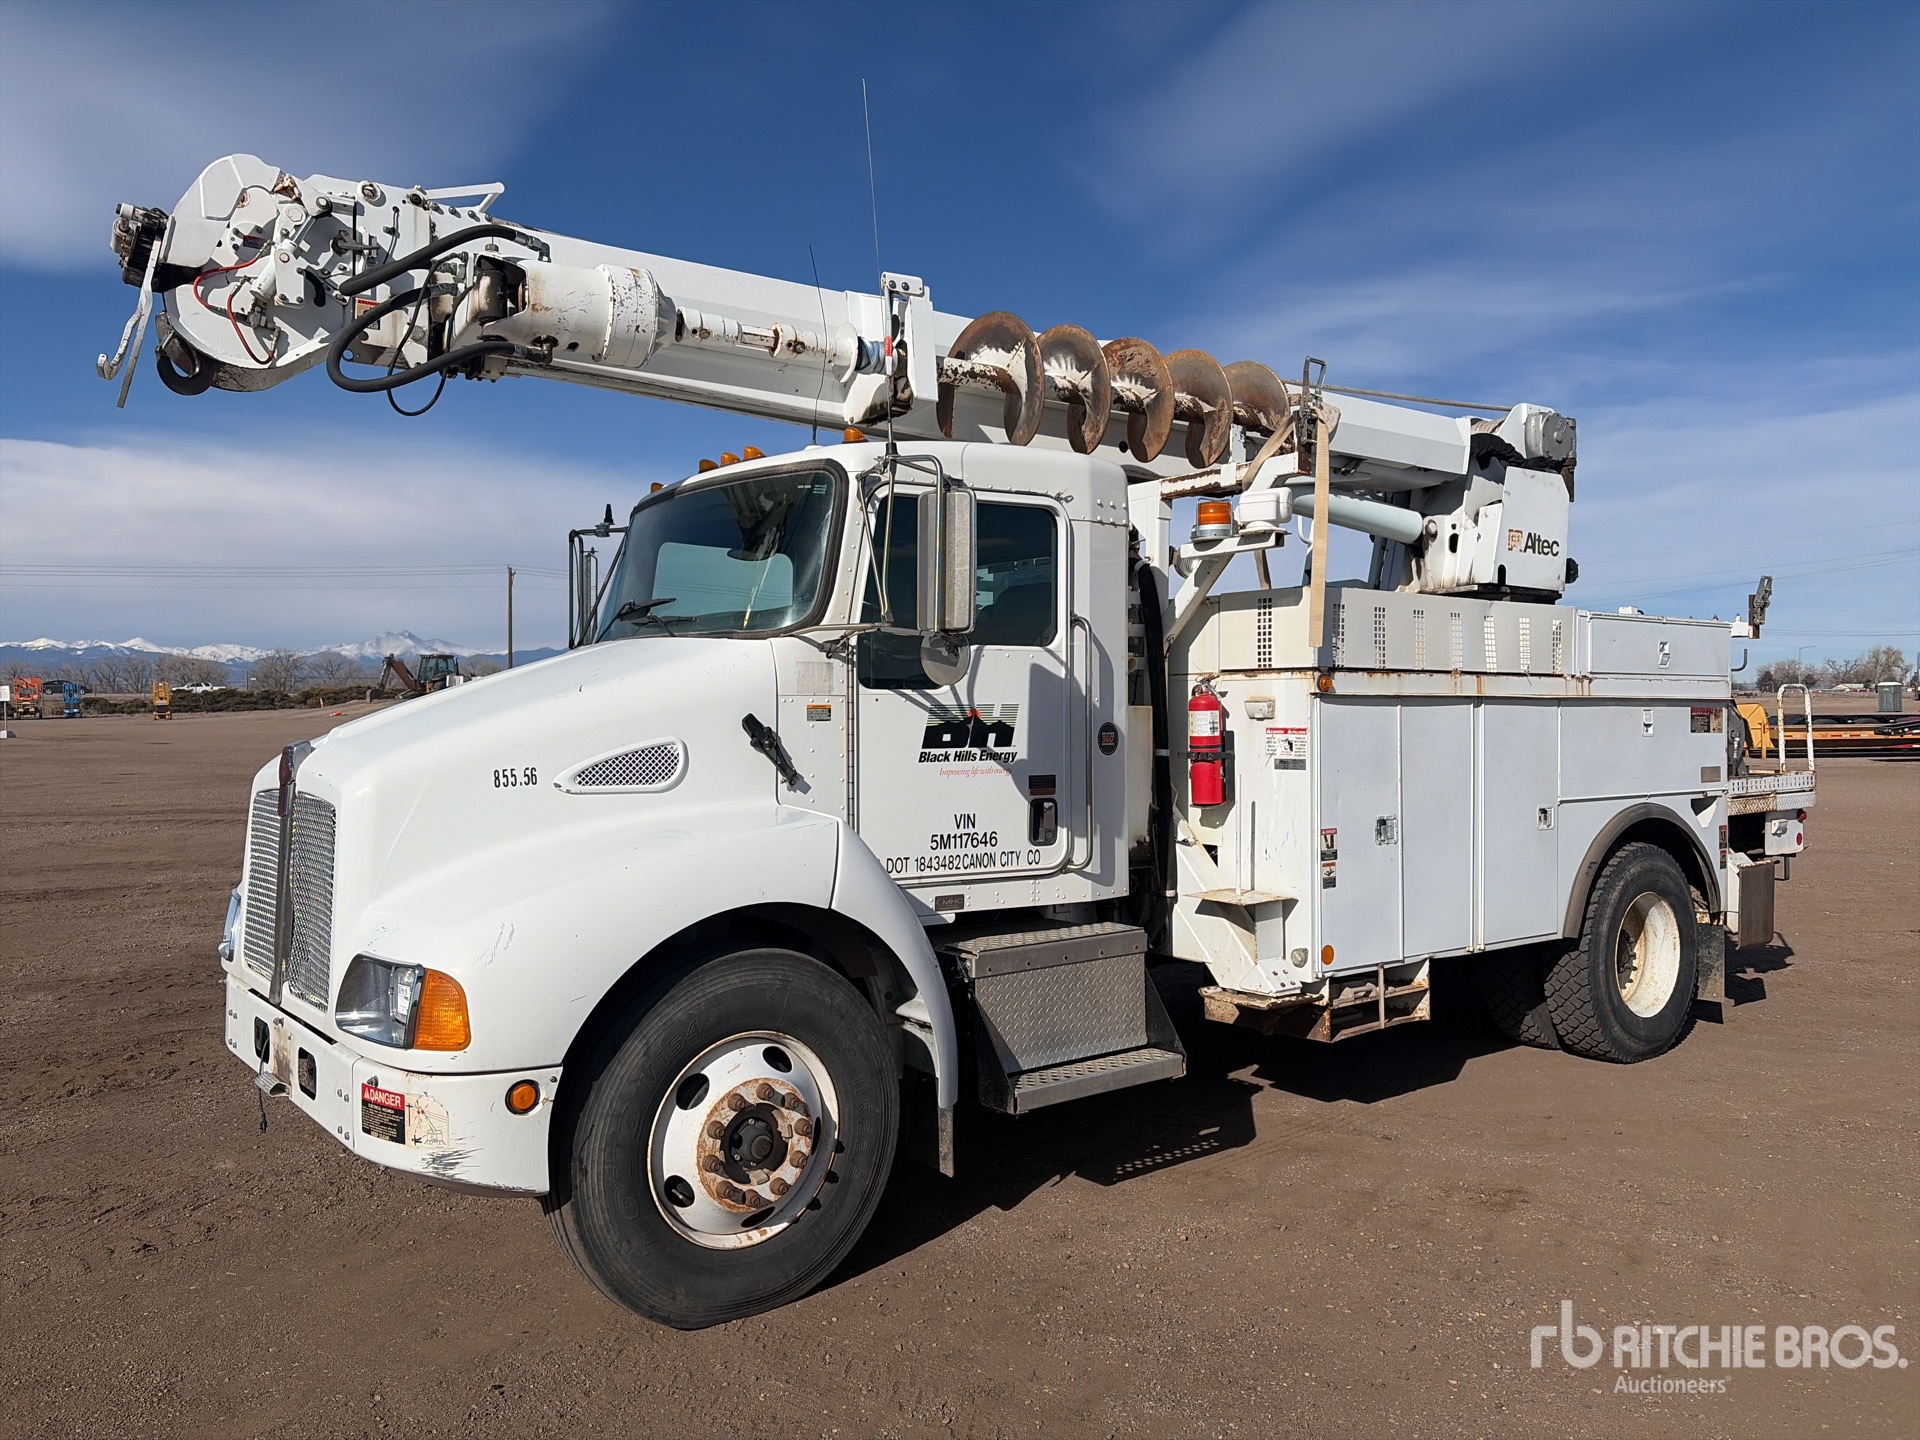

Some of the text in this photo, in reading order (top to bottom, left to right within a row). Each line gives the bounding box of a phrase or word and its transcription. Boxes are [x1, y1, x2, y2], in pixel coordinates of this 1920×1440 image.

[1523, 532, 1560, 557] Altec
[918, 750, 1018, 763] Black Hills Energy
[493, 767, 538, 788] 855.56
[939, 767, 970, 778] Improving
[971, 765, 980, 777] life
[980, 766, 994, 775] with
[954, 813, 976, 829] VIN
[930, 831, 998, 850] 5M117646
[886, 849, 1041, 873] DOT 1843482 CANON CITY CO
[369, 1088, 401, 1107] DANGER
